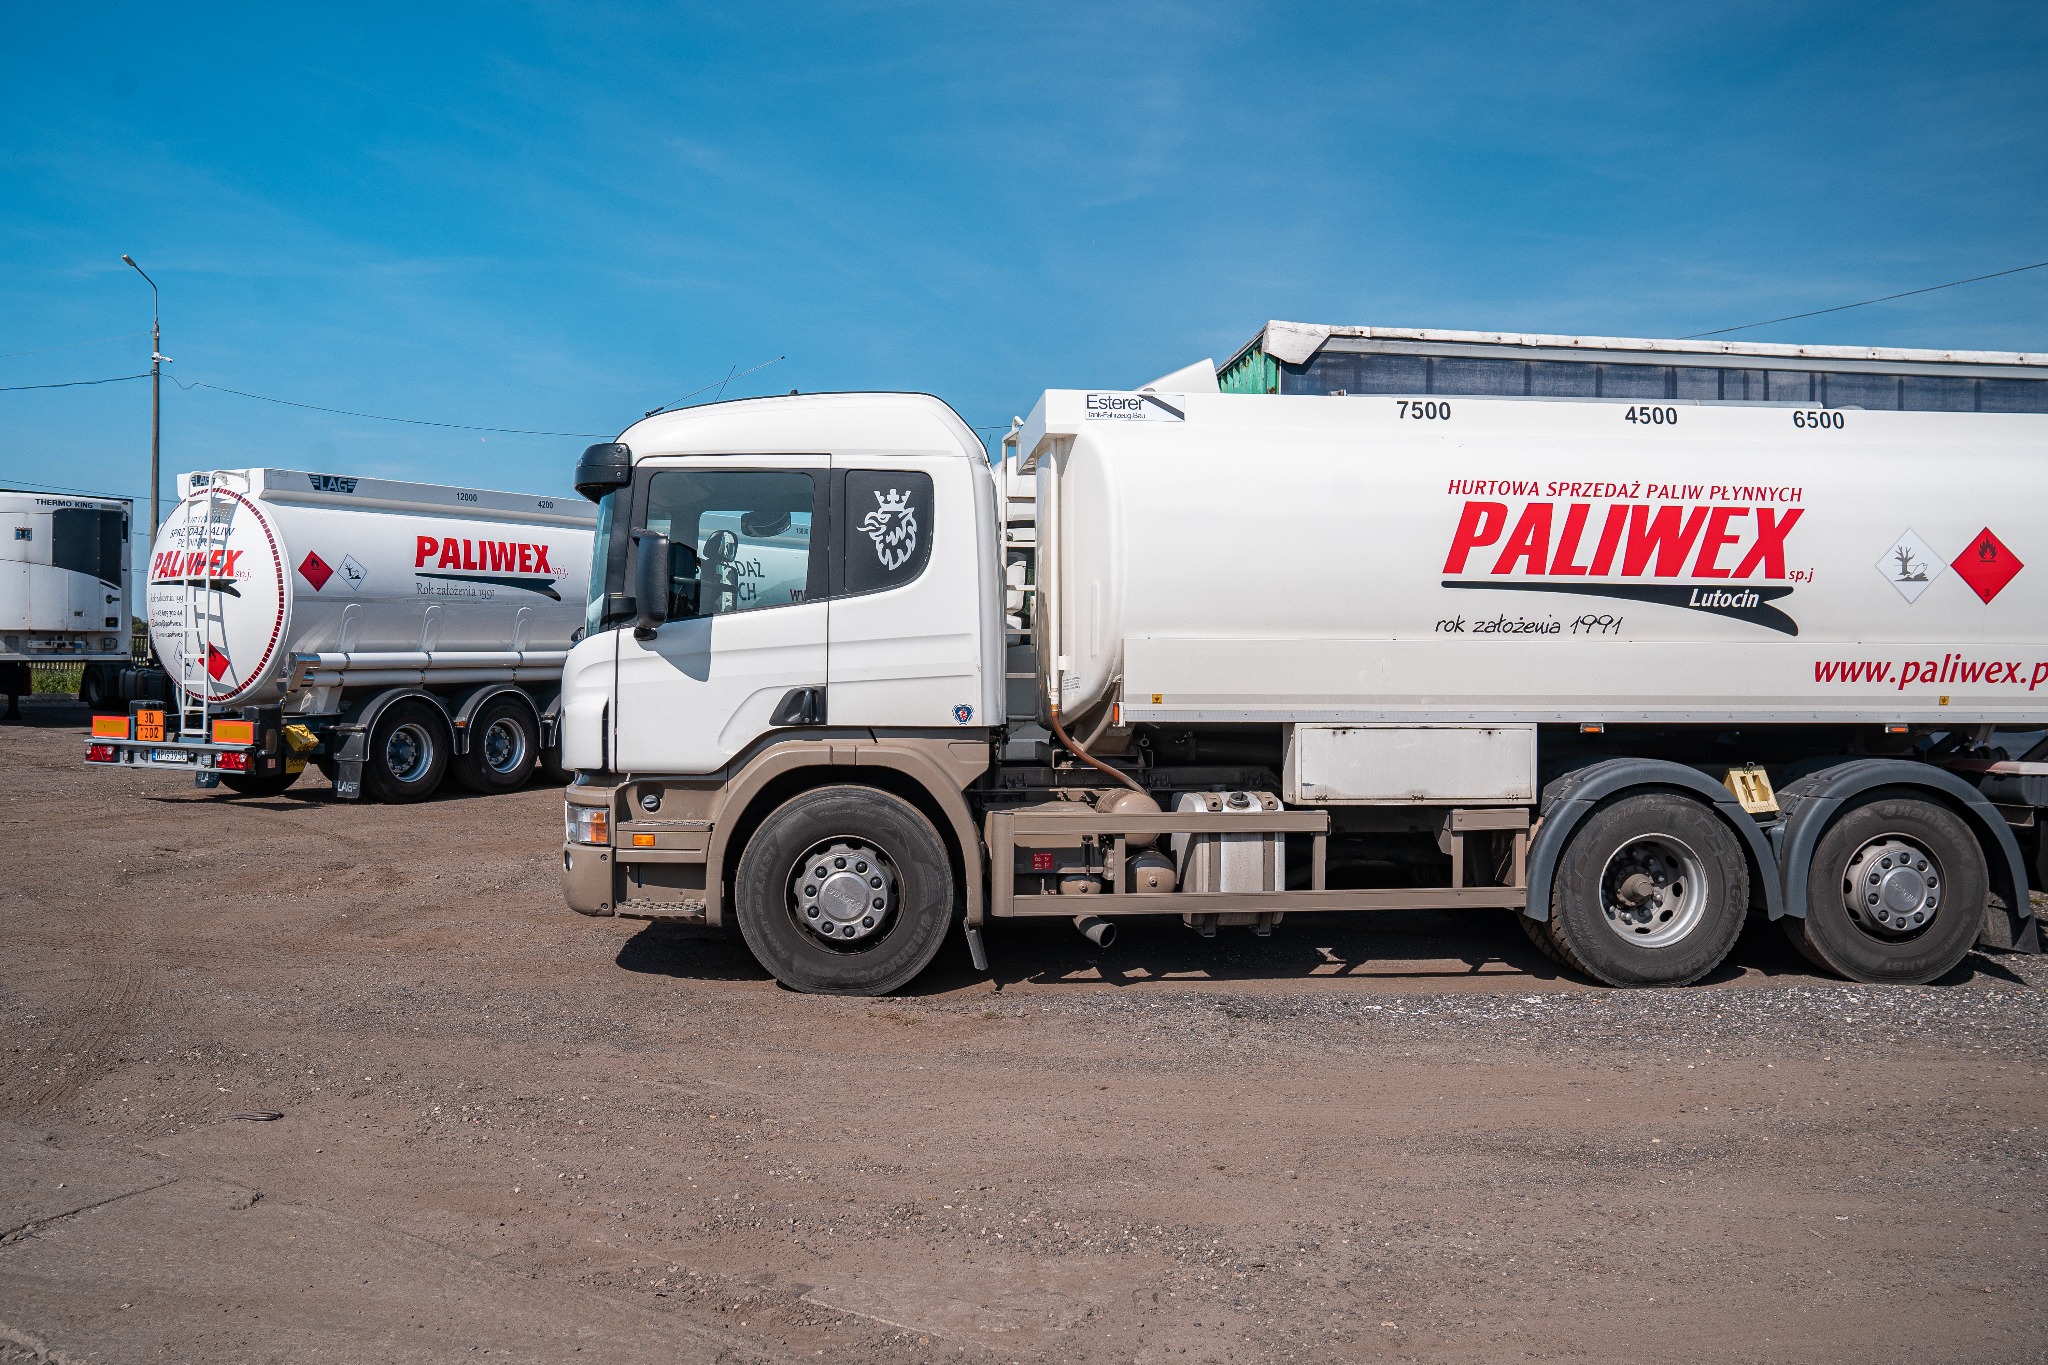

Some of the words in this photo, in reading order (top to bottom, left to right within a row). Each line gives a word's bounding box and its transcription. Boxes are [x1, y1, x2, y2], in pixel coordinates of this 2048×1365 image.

[1086, 394, 1145, 410] Esterer
[1396, 400, 1451, 420] 7500
[1624, 406, 1677, 425] 4500
[1792, 411, 1844, 429] 6500
[320, 475, 348, 492] LAG
[1448, 479, 1540, 496] HURTOWA
[1546, 480, 1641, 499] SPRZEDAŻ
[1647, 483, 1704, 500] PALIW
[1709, 485, 1803, 502] PŁYNNYCH
[35, 498, 72, 508] THERMO
[75, 501, 93, 509] KING
[456, 492, 478, 502] 12000
[537, 500, 554, 509] 4200
[1442, 500, 1805, 580] PALIWEX
[1788, 568, 1814, 583] sp.j
[415, 536, 551, 574] PALIWEX
[152, 550, 244, 580] PALIWEX
[734, 558, 765, 578] DAŻ
[416, 582, 433, 595] Rok
[437, 582, 477, 597] założenia
[479, 589, 495, 600] 1991
[738, 582, 757, 600] CH
[1689, 588, 1760, 608] Lutocin
[1984, 588, 1990, 597] 3
[1435, 614, 1466, 633] rok
[1472, 613, 1561, 634] założenia
[1570, 614, 1624, 635] 1991
[337, 780, 353, 793] LAG
